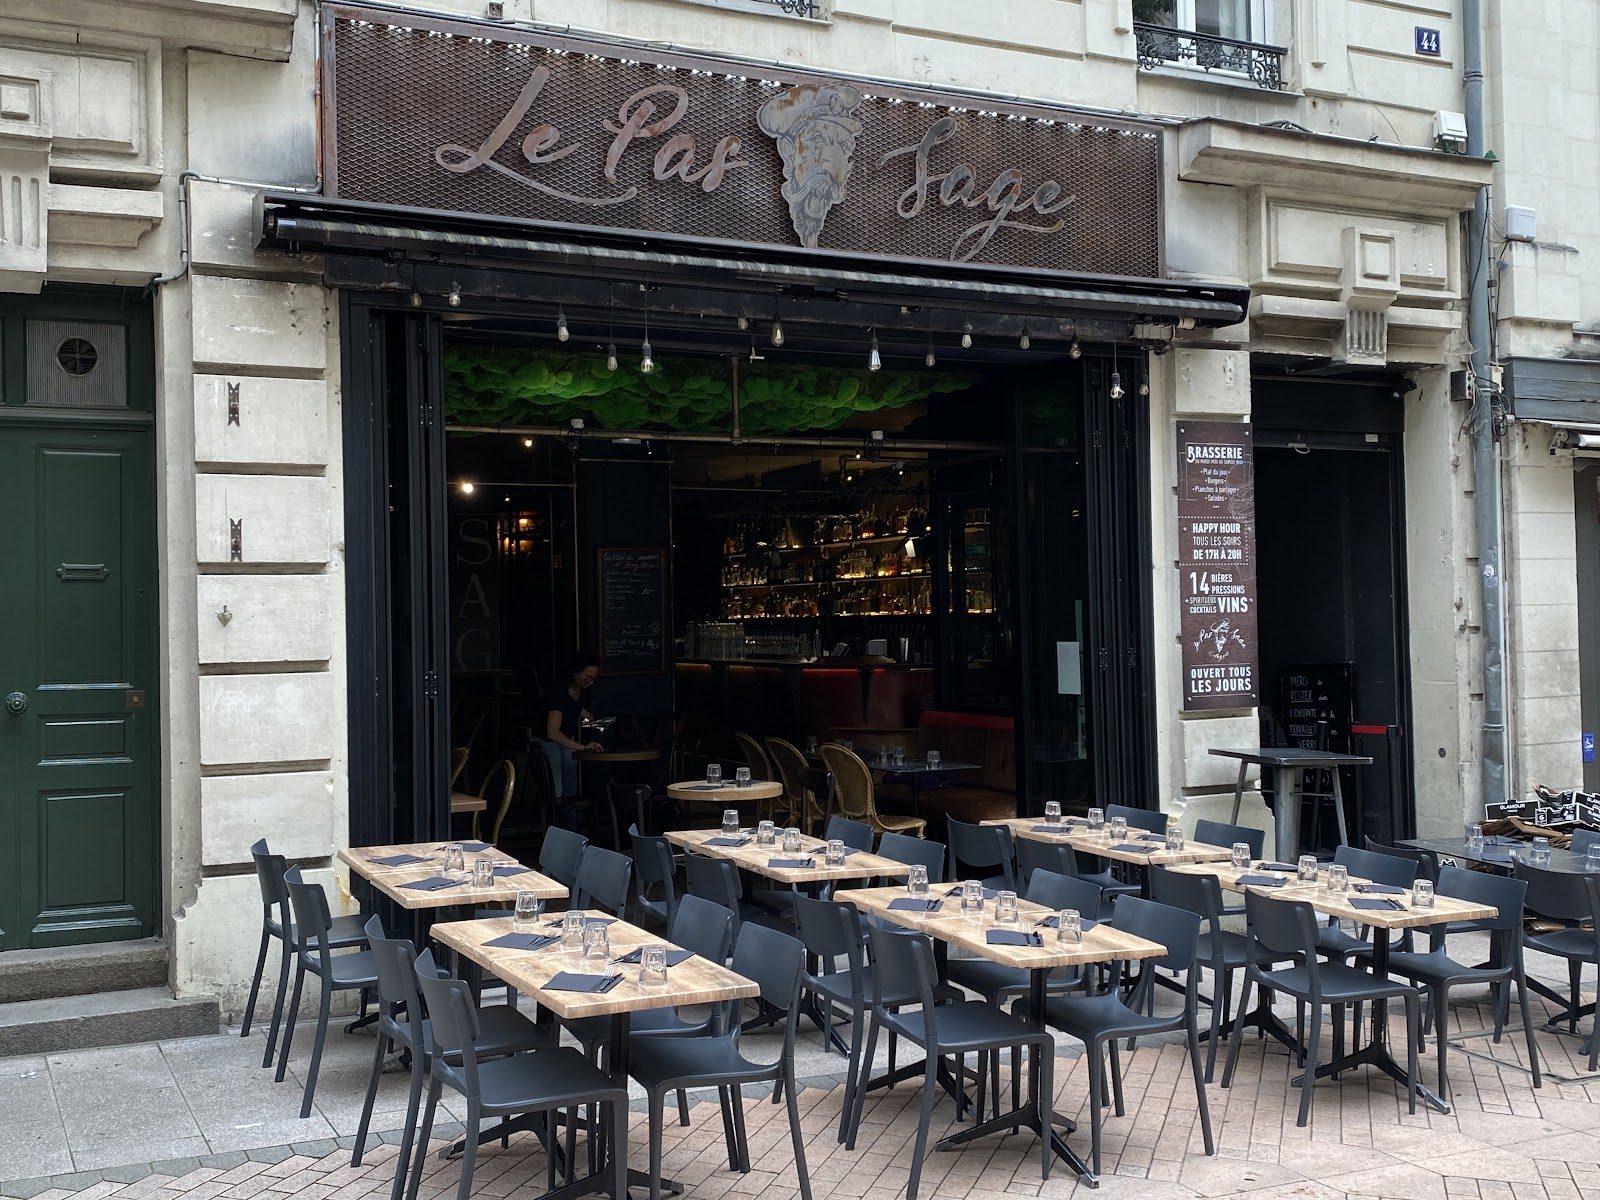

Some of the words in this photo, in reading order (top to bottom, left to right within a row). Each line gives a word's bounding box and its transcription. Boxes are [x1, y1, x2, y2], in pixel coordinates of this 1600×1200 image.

[1421, 32, 1438, 51] 44
[435, 66, 637, 205] Le
[602, 84, 748, 193] Pas
[876, 116, 1077, 263] Sage
[1187, 446, 1243, 463] BRASSERIE
[1193, 523, 1218, 534] HAPPY
[1220, 523, 1241, 534] HOUR
[1193, 536, 1209, 546] TOUS
[1210, 536, 1222, 546] LES
[1223, 536, 1242, 546] SOIRS
[1193, 549, 1204, 560] DE
[1205, 549, 1220, 560] 17H
[1220, 547, 1227, 560] À
[1227, 549, 1242, 560] 20H
[1190, 571, 1210, 595] 14
[1211, 573, 1233, 583] BIÈRES
[1211, 585, 1245, 595] PRESSIONS
[1190, 606, 1217, 614] COCKTAILS
[1217, 596, 1249, 614] VINS
[1191, 668, 1225, 679] OUVERT
[1229, 666, 1251, 678] TOUS
[1191, 680, 1212, 693] LES
[1215, 678, 1251, 692] JOURS
